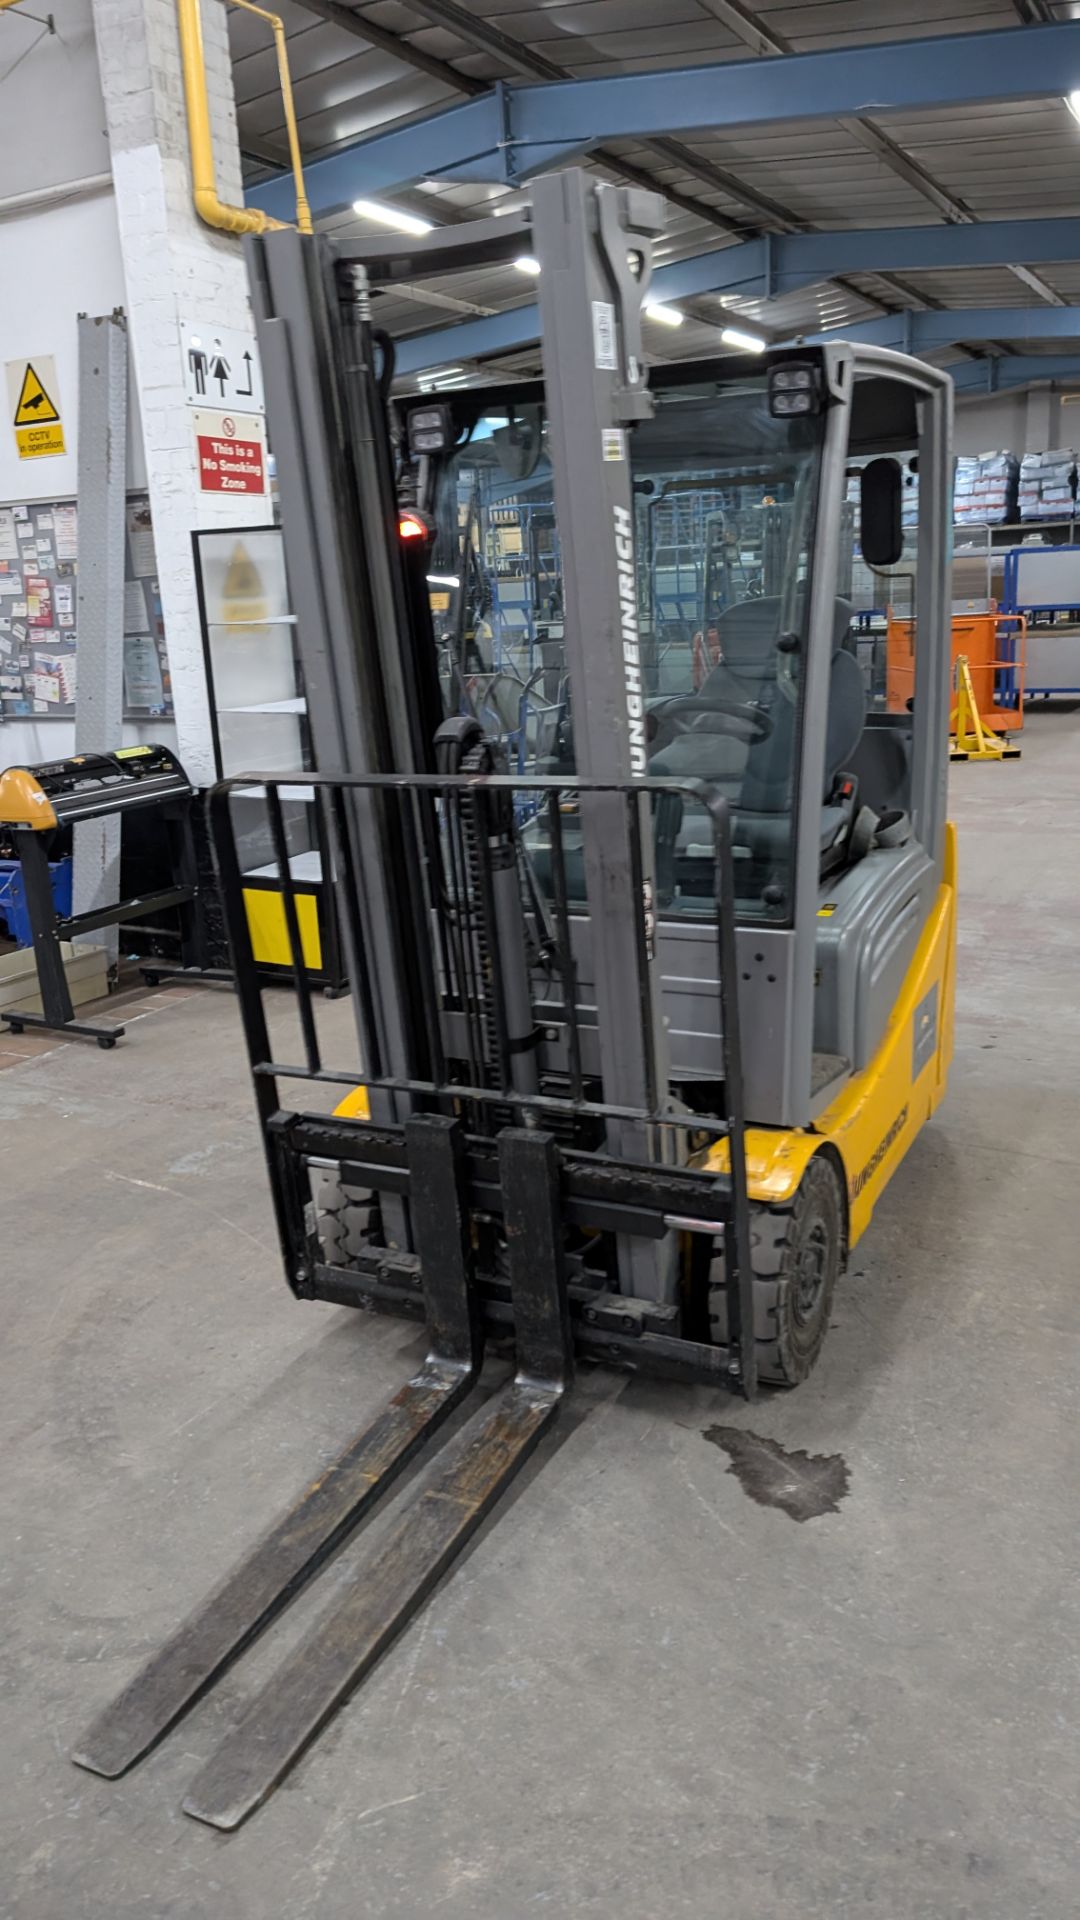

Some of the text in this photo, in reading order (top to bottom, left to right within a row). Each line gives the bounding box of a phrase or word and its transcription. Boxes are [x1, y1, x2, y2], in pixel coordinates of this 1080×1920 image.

[28, 430, 50, 441] CCTV
[28, 440, 63, 451] operation
[211, 442, 254, 458] This is a
[202, 457, 261, 477] No Smoking
[220, 476, 247, 489] Zone
